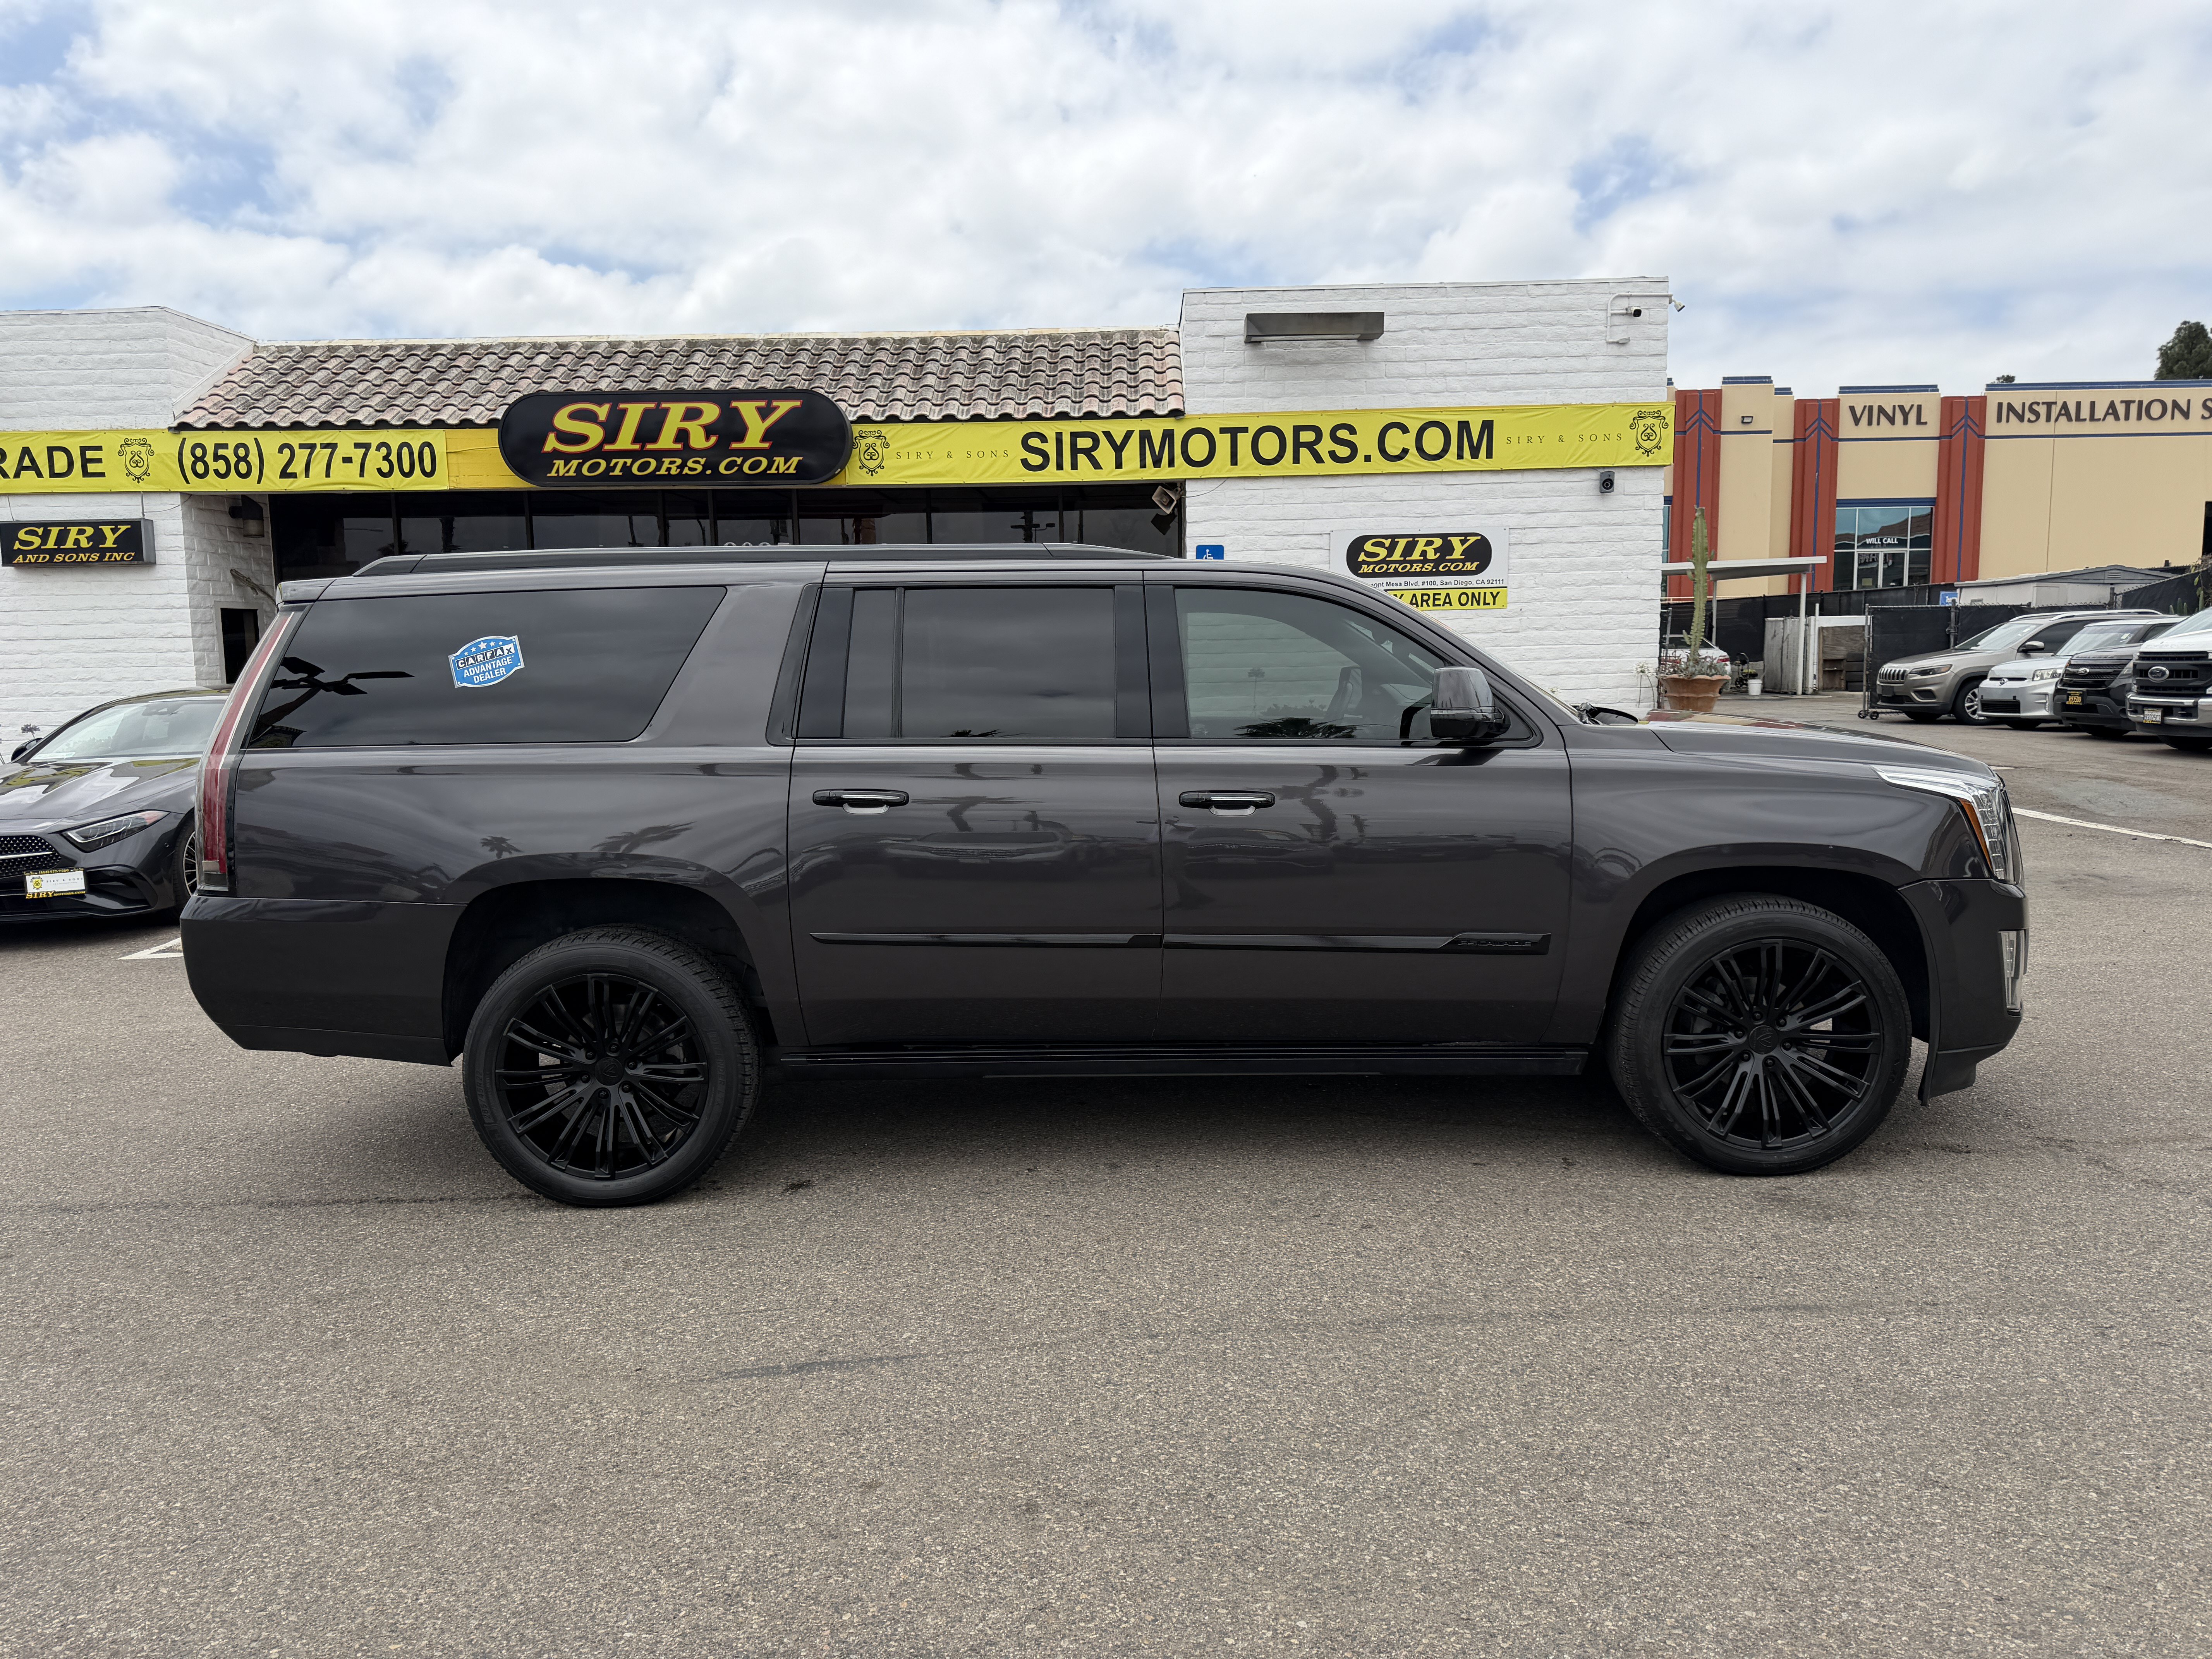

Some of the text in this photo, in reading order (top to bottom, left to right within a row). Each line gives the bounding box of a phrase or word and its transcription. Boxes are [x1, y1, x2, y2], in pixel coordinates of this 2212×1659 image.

[1849, 404, 1928, 426] VINYL
[1996, 398, 2191, 423] INSTALLATION
[541, 400, 803, 453] SIRY
[896, 451, 934, 460] SIRY
[966, 450, 1009, 458] SONS
[1020, 419, 1494, 472] SIRYMOTORS.COM
[1506, 435, 1545, 445] SIRY
[1578, 433, 1622, 442] SONS
[177, 437, 437, 484] (858) 277-7300
[546, 456, 803, 477] MOTORS.COM
[13, 525, 131, 550] SIRY
[12, 552, 135, 563] AND SONS INC
[1357, 536, 1481, 562] SIRY
[1358, 562, 1480, 574] MOTORS.COM
[1408, 592, 1453, 608] AREA
[1458, 591, 1501, 606] ONLY
[457, 646, 513, 668] CARFAX
[464, 657, 513, 678] ADVANTAGE
[473, 667, 506, 684] DEALER
[26, 891, 55, 899] SIRY
